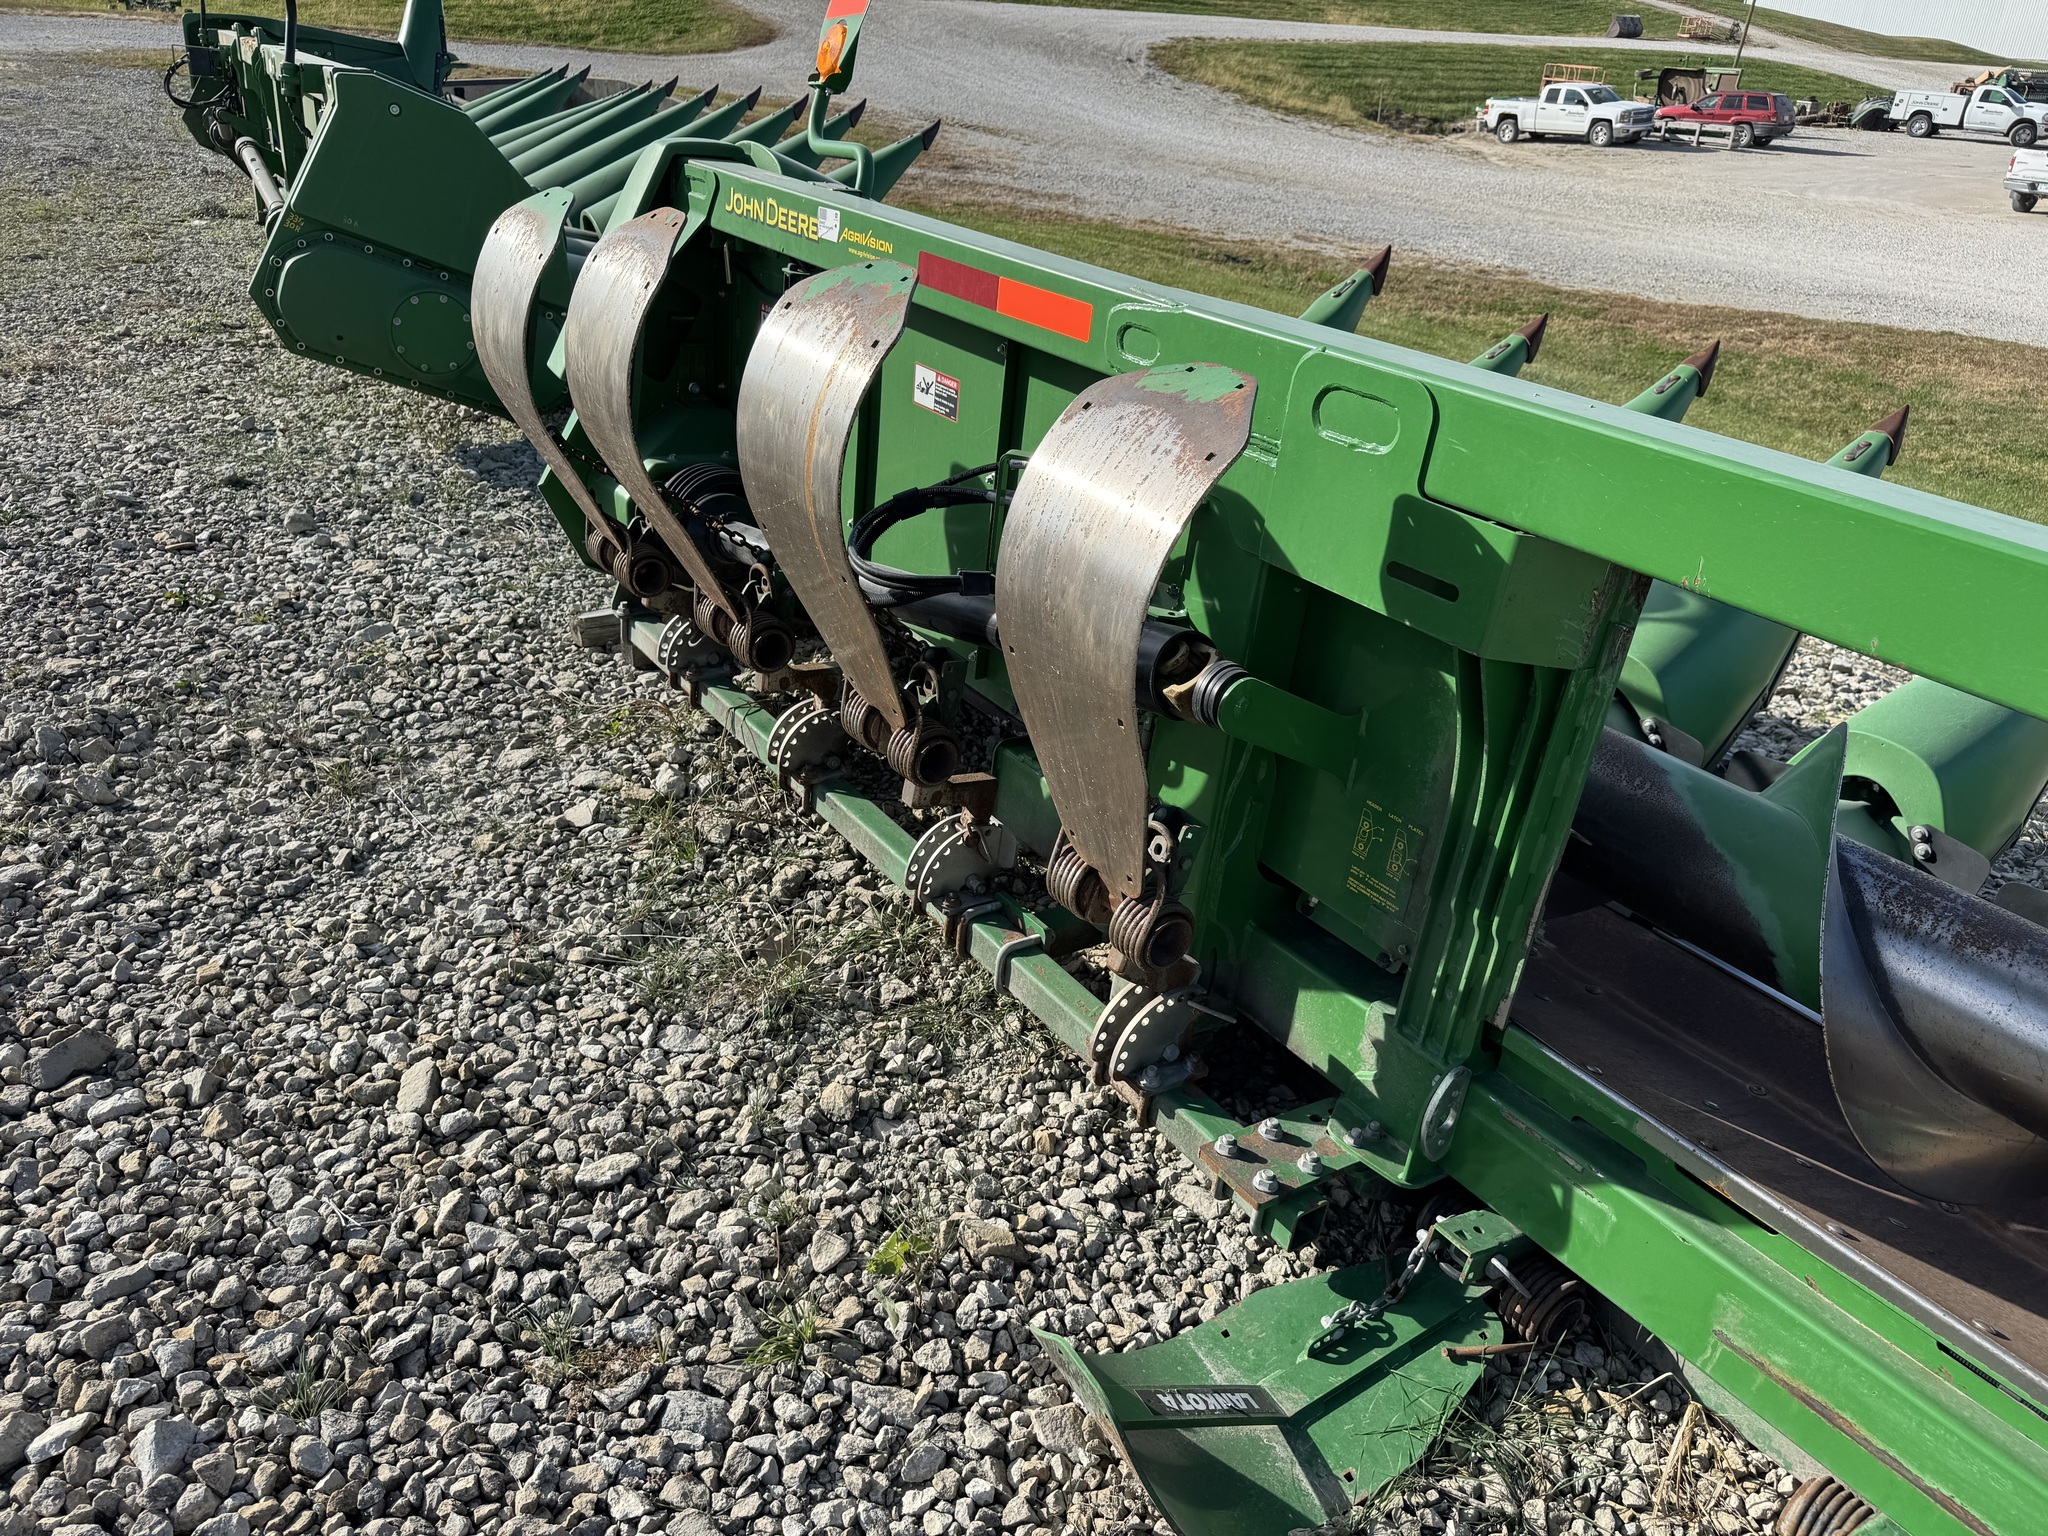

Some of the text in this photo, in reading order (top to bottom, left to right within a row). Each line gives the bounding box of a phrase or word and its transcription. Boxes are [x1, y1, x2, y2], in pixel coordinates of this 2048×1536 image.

[725, 186, 819, 241] JOHN DEERE
[839, 228, 893, 254] AGRIVISION
[1388, 812, 1402, 823] LATCH
[1408, 824, 1424, 837] PLATES
[1156, 1392, 1260, 1411] LANKOTA
